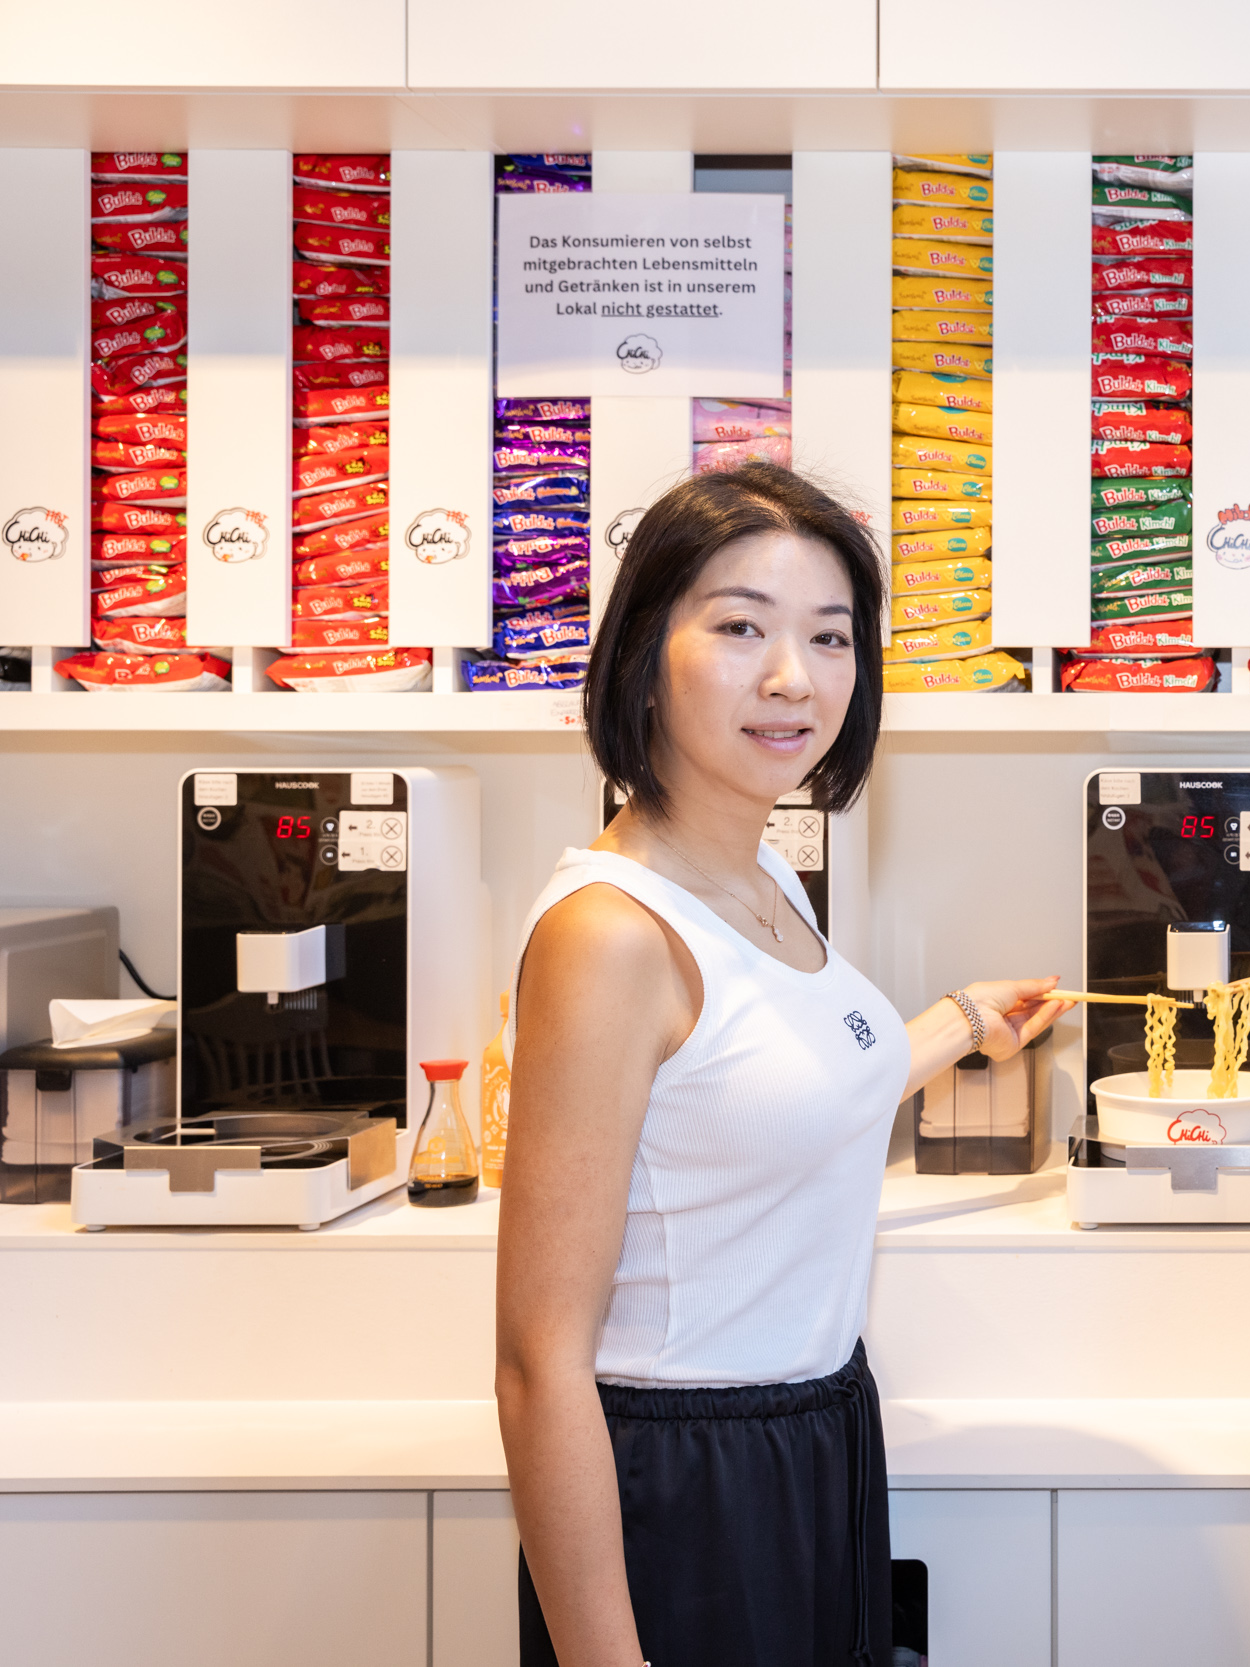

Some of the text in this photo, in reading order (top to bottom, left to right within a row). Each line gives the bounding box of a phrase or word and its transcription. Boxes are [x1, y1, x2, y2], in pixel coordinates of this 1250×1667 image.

[920, 181, 956, 197] Buldak
[1105, 188, 1149, 202] Buldak
[932, 216, 968, 230] Buldak
[128, 228, 176, 249] Buldak
[530, 235, 752, 249] Das Konsumieren von selbst
[1116, 234, 1164, 251] Buldak
[523, 257, 758, 274] mitgebrachten Lebensmitteln
[928, 251, 966, 266] Buldak
[525, 279, 756, 293] und Getränken ist in unserem
[1103, 269, 1185, 287] Buldak Kimchi
[933, 289, 972, 303] Buldak
[556, 302, 723, 318] Lokal nicht gestattet.
[1107, 297, 1188, 314] Buldak Kimchi
[937, 321, 975, 336] Buldak
[94, 332, 140, 356] Buldak
[1111, 333, 1191, 354] Buldak Kimchi
[933, 353, 971, 367] Buldak
[1098, 375, 1143, 393] Buldak
[945, 395, 982, 408] Buldak
[538, 401, 582, 420] Buldak
[136, 423, 185, 441] Buldak
[529, 426, 573, 443] Buldak
[715, 426, 752, 438] Buldak
[948, 426, 983, 440] Buldak
[1147, 431, 1182, 444] Kimchi
[912, 480, 948, 493] Buldak
[1101, 488, 1146, 506] Buldak
[509, 514, 555, 532] Buldak
[902, 510, 938, 525] Buldak
[1093, 516, 1175, 534] Buldak Kimchi
[898, 541, 934, 557] Buldak
[1106, 539, 1151, 558] Buldak
[904, 571, 940, 587] Buldak
[1129, 567, 1172, 586] Buldak
[1125, 595, 1170, 613] Buldak
[539, 626, 587, 646] Buldak
[504, 668, 546, 688] Buldak
[923, 673, 959, 688] Buldak
[1116, 672, 1198, 689] Buldak Kimchi
[1179, 782, 1223, 790] HAUSCOOK
[276, 815, 311, 838] 85
[366, 820, 376, 829] 2.
[783, 817, 793, 826] 2.
[1181, 815, 1215, 838] 85
[360, 847, 369, 857] 1.
[784, 849, 793, 858] 1.
